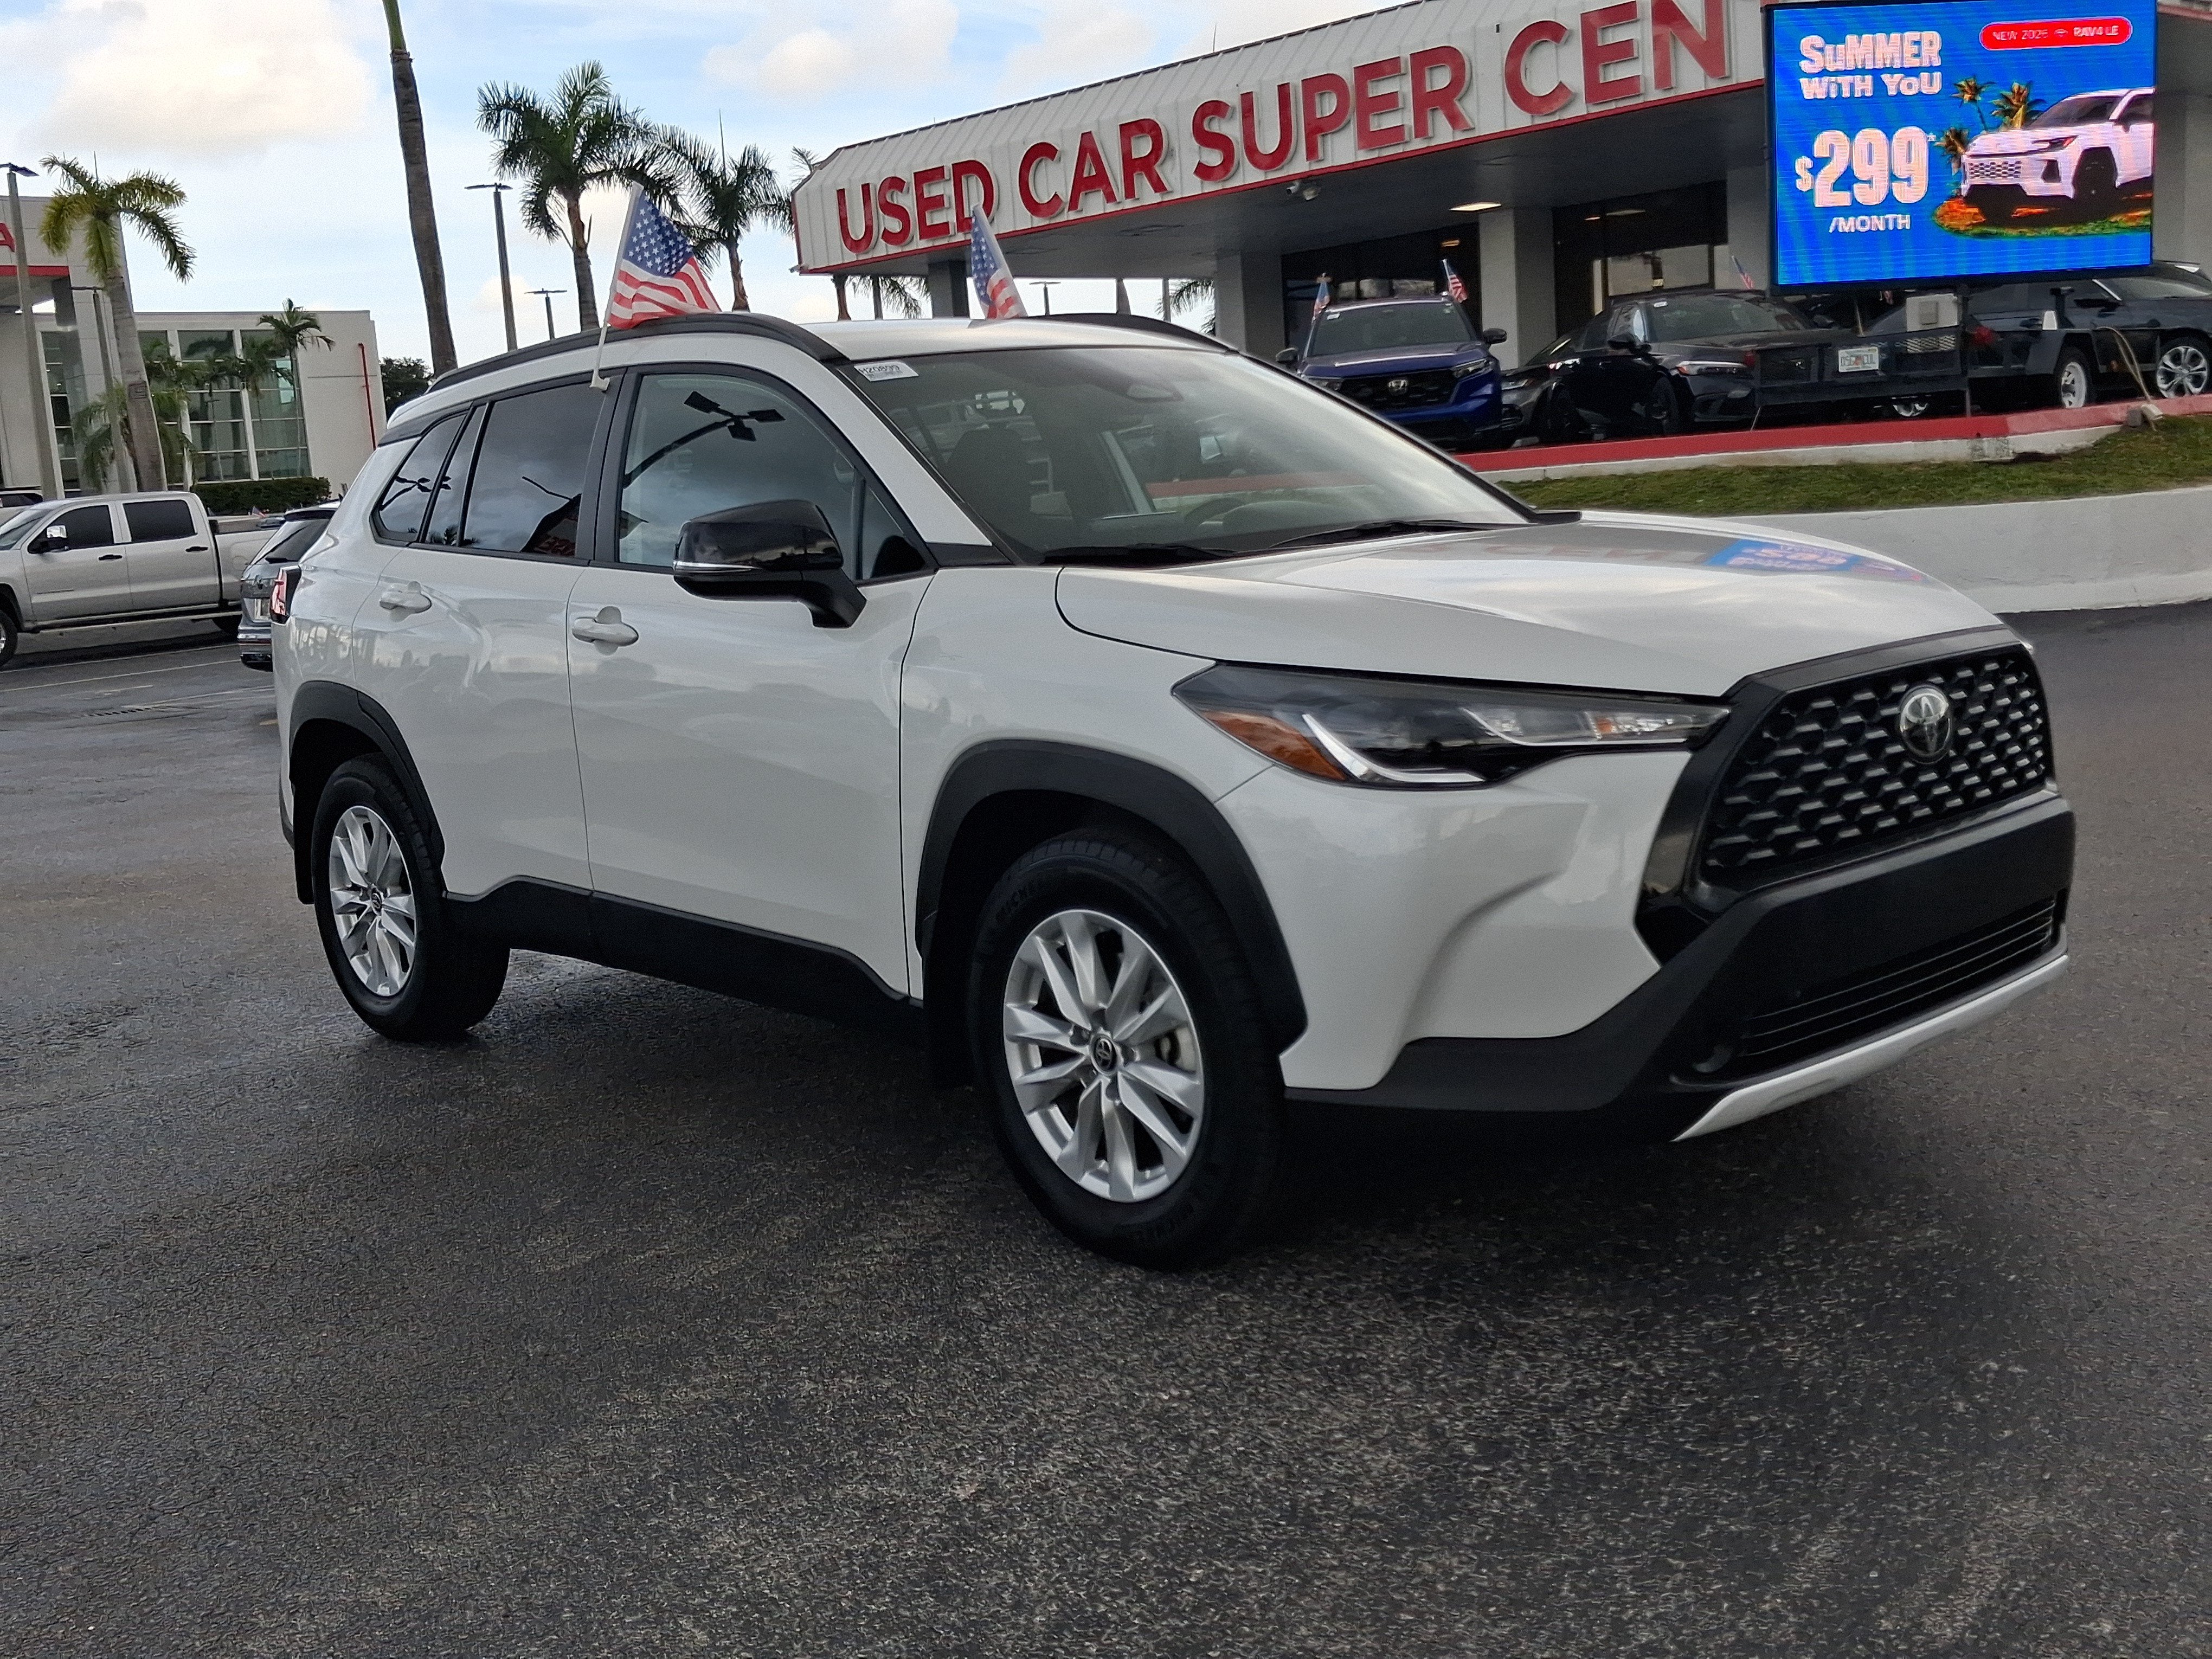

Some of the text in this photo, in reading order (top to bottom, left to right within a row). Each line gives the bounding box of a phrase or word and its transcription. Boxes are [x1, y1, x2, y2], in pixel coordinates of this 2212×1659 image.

[836, 0, 1782, 254] USED CAR SUPER CEN
[1828, 214, 1911, 233] /MONTH
